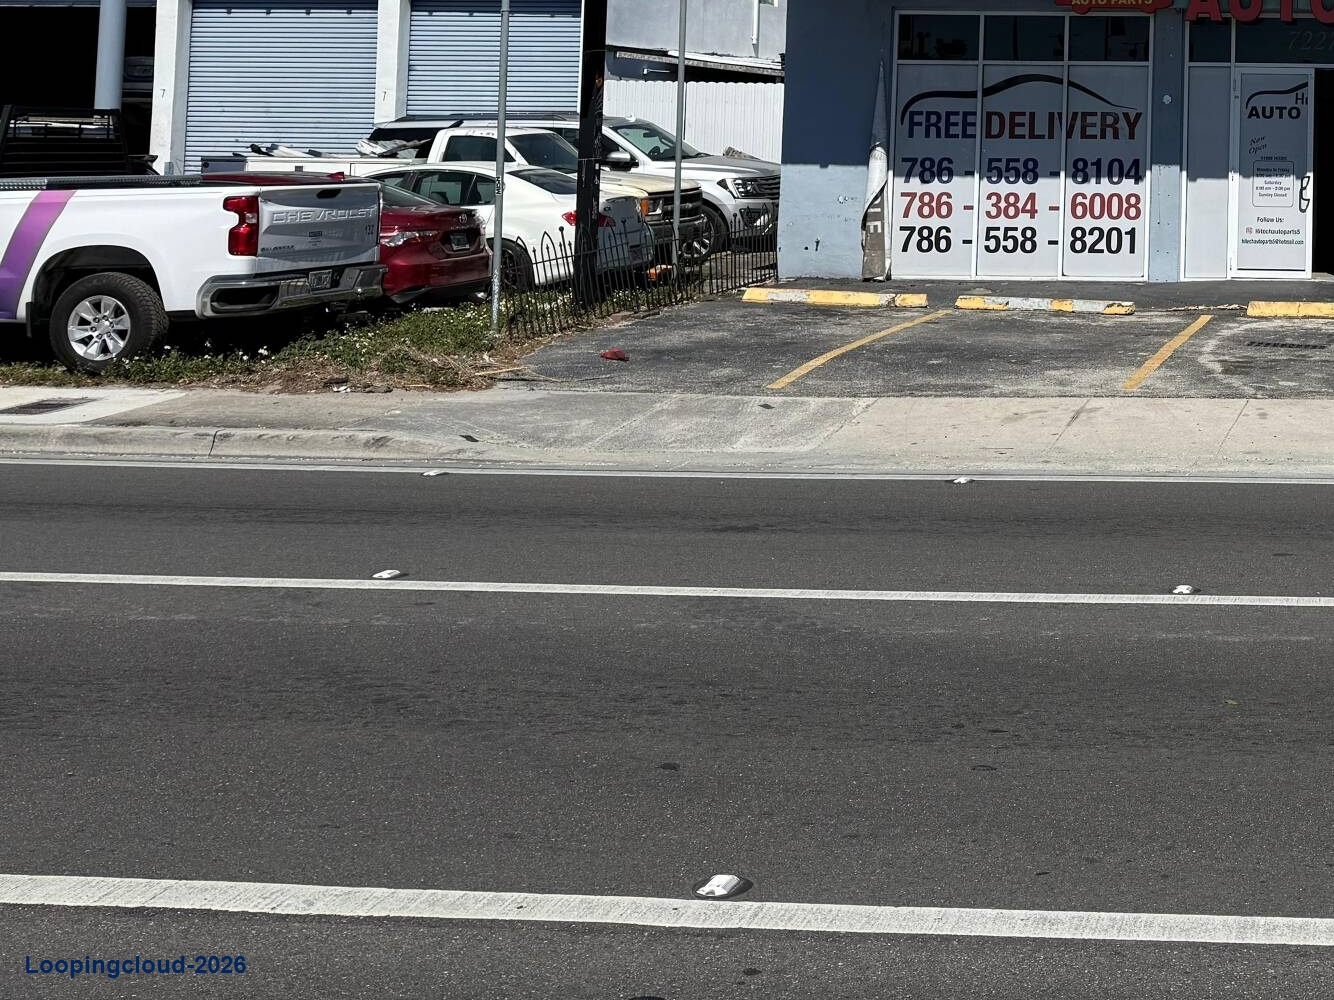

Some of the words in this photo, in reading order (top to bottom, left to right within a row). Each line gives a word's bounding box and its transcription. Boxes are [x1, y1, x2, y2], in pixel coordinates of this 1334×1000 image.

[908, 111, 977, 139] FREE
[985, 111, 1142, 140] DELIVERY
[1247, 106, 1301, 119] AUTO
[901, 157, 954, 184] 786
[986, 157, 1039, 185] 558
[1071, 158, 1142, 185] 8104
[273, 206, 377, 223] CHEVROLET
[900, 192, 953, 219] 786
[985, 192, 1038, 219] 384
[1070, 192, 1141, 220] 6008
[899, 226, 952, 253] 786
[984, 226, 1038, 254] 558
[1069, 226, 1136, 254] 8201
